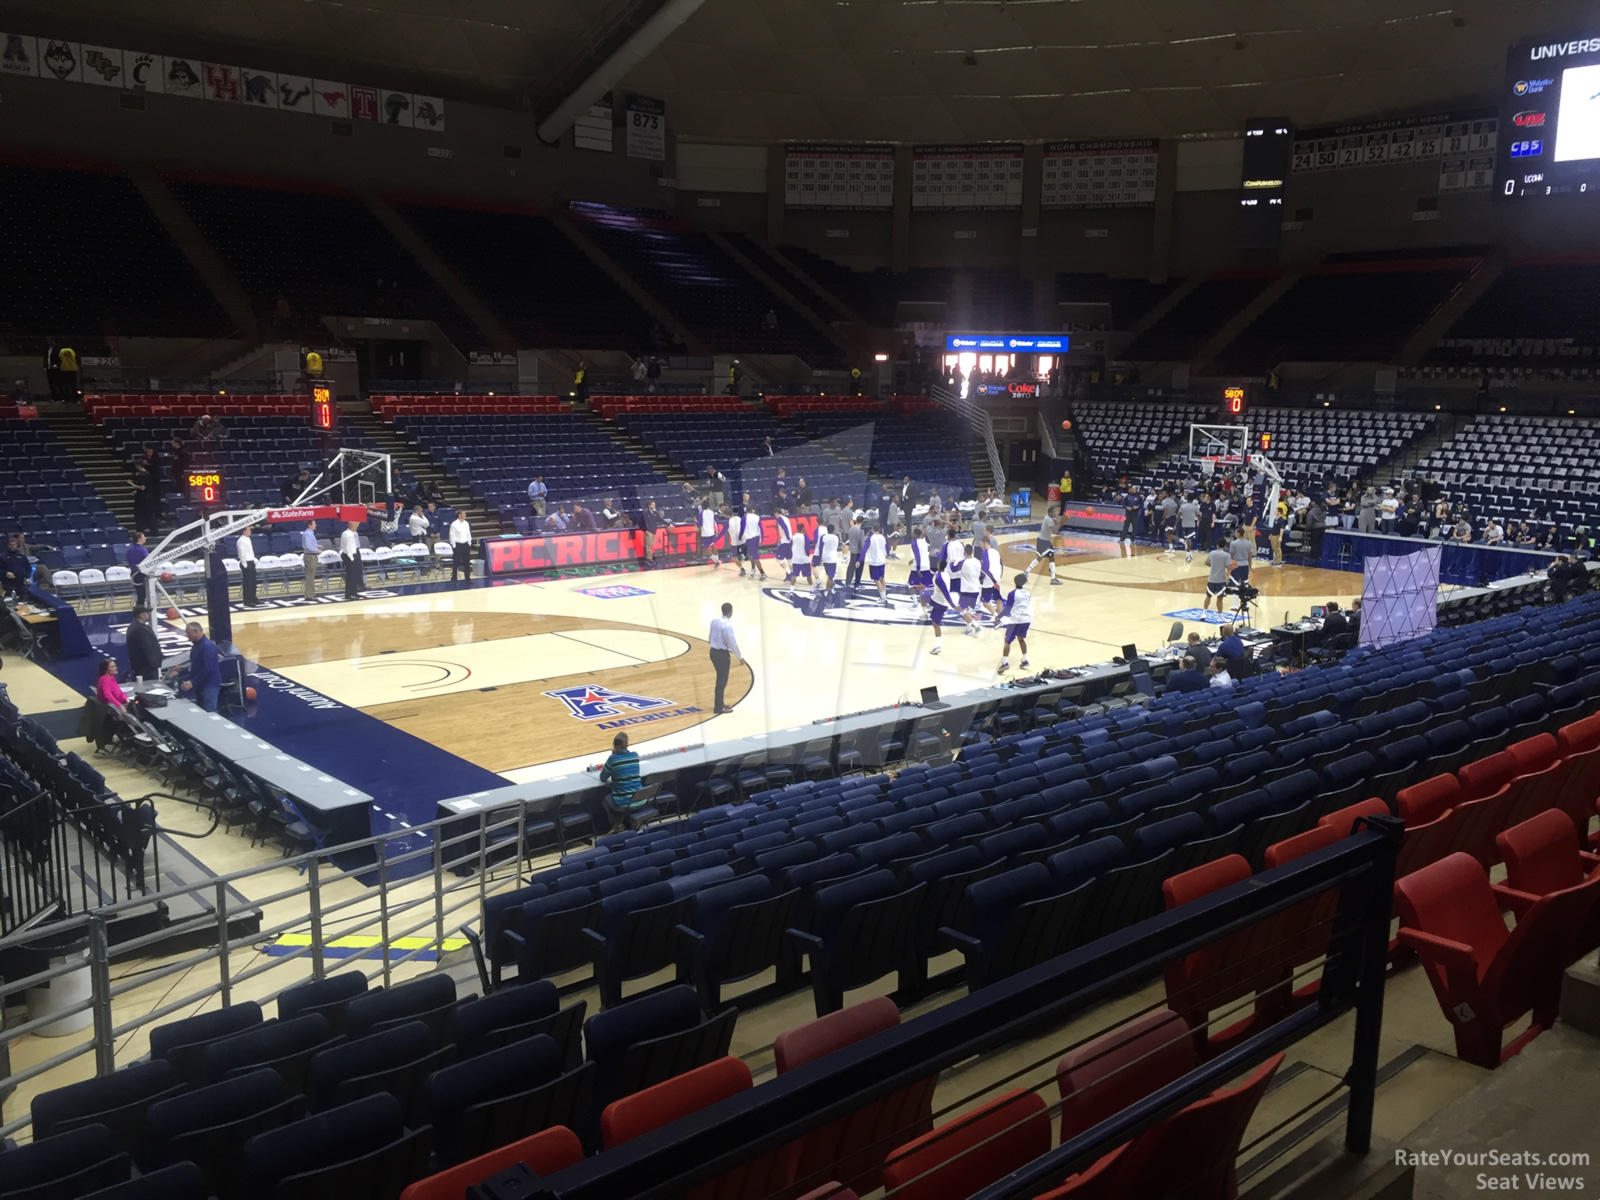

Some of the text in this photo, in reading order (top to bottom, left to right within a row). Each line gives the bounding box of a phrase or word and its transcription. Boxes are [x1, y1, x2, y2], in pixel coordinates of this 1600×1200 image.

[1530, 38, 1600, 60] UNIVERS
[633, 113, 658, 129] 873
[1080, 140, 1153, 150] CHAMPIONSHIP
[1394, 144, 1410, 156] 42
[1421, 141, 1434, 153] 25
[1511, 140, 1540, 152] CBS
[1319, 152, 1334, 164] 50
[1345, 150, 1358, 162] 21
[1369, 147, 1383, 159] 52
[1296, 155, 1310, 168] 24
[1504, 179, 1514, 195] 0
[1545, 186, 1551, 195] 3
[1580, 183, 1586, 192] 0
[1008, 383, 1036, 393] Coke
[1224, 389, 1244, 398] 58:09
[1232, 398, 1241, 412] 0
[322, 404, 330, 427] 0
[189, 475, 220, 487] 58:09
[204, 487, 214, 500] 0
[489, 538, 551, 572] P.C.
[247, 672, 343, 709] Alumni Court
[596, 706, 704, 730] AMERICAN
